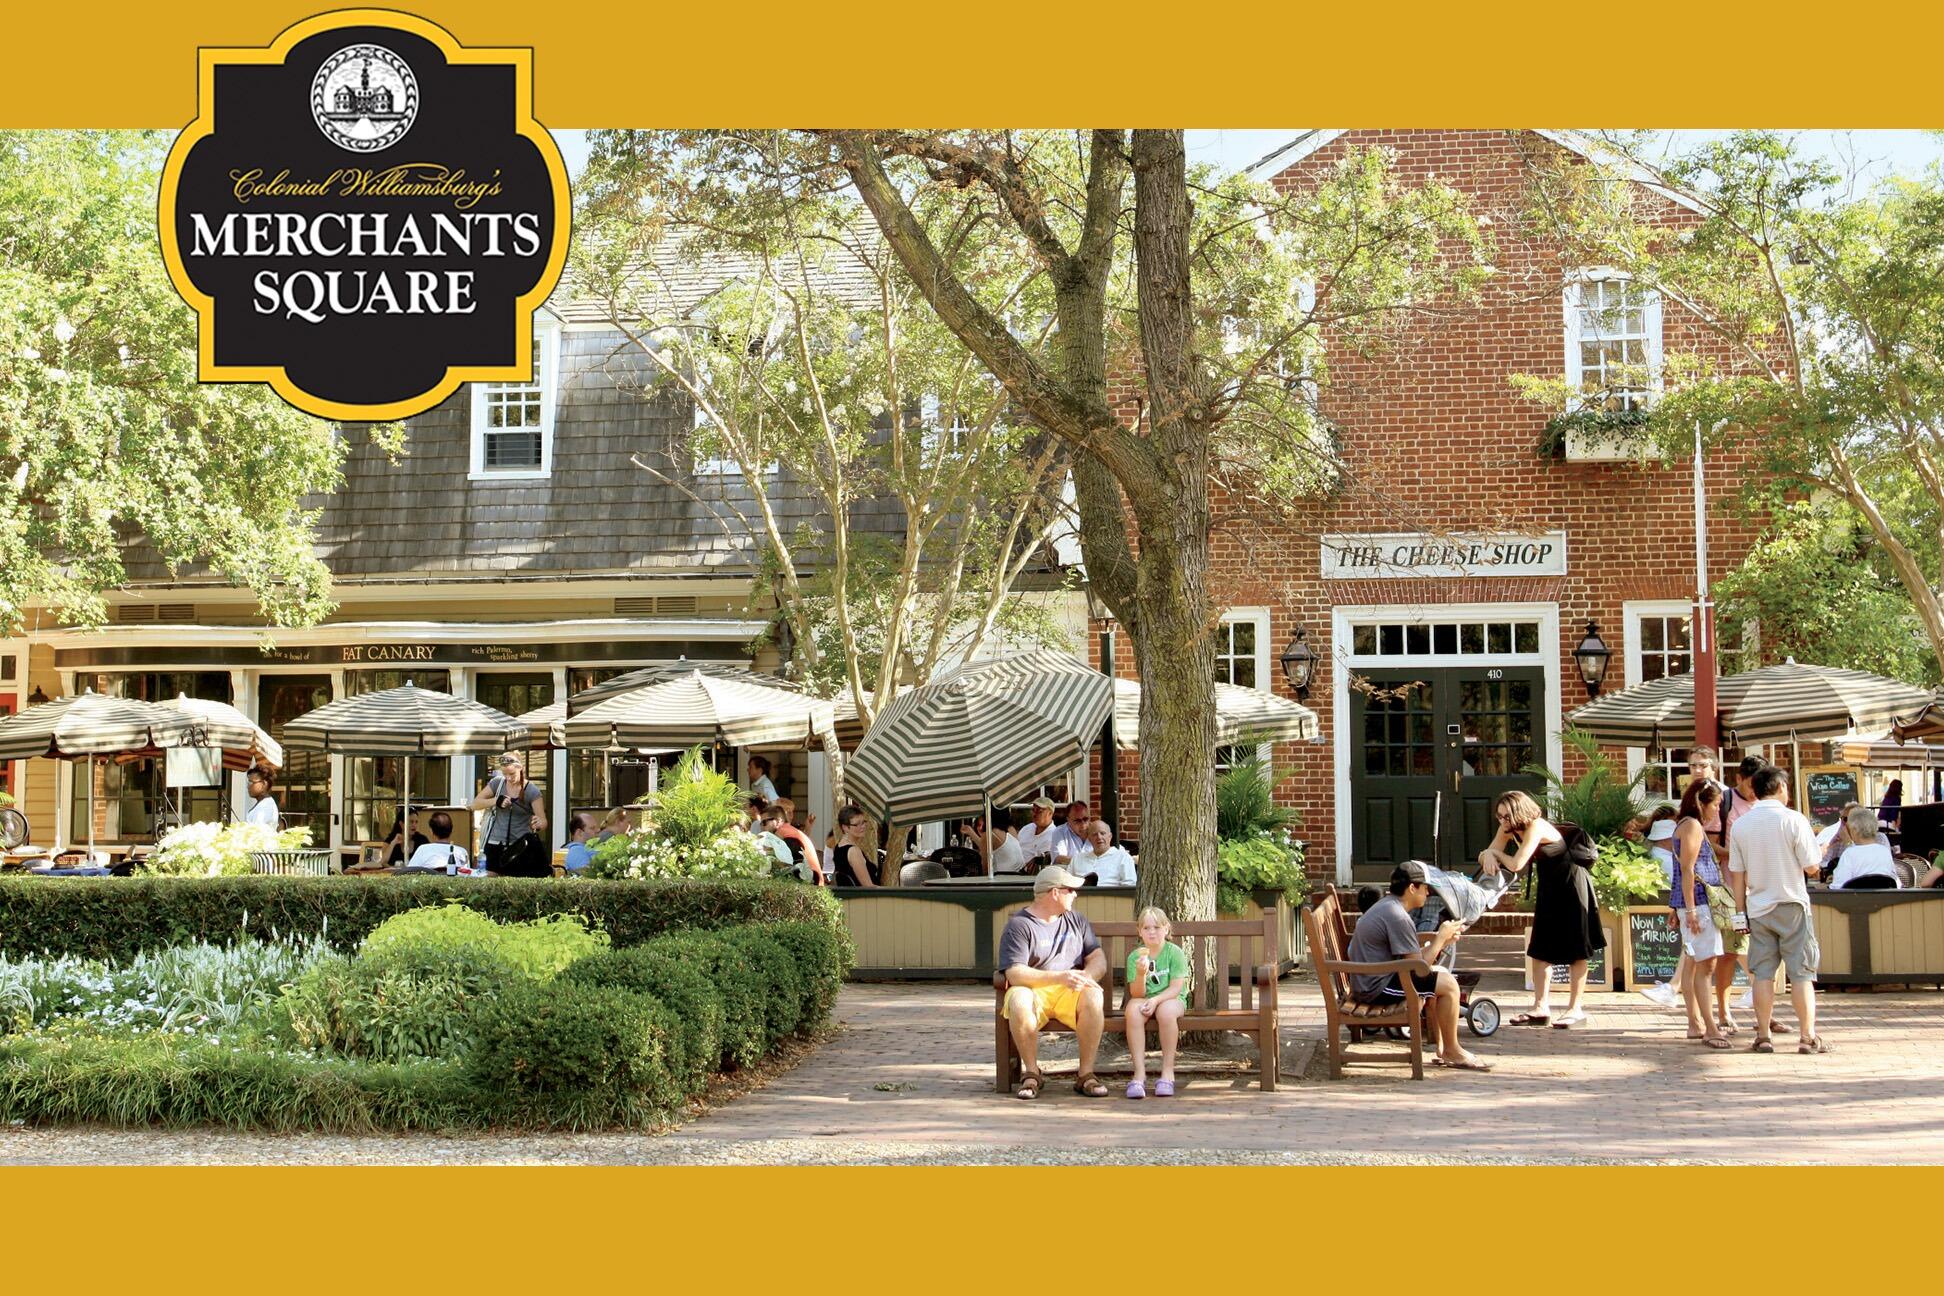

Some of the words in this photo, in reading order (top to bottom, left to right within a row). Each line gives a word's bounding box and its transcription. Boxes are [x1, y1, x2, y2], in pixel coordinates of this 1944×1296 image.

[1337, 547, 1383, 567] THE
[1392, 545, 1486, 566] CHEESE
[1492, 543, 1553, 565] SHOP
[342, 646, 363, 661] FAT
[367, 645, 436, 660] CANARY
[471, 646, 485, 654] rich
[1487, 669, 1503, 679] 410
[1641, 928, 1679, 943] HIRING
